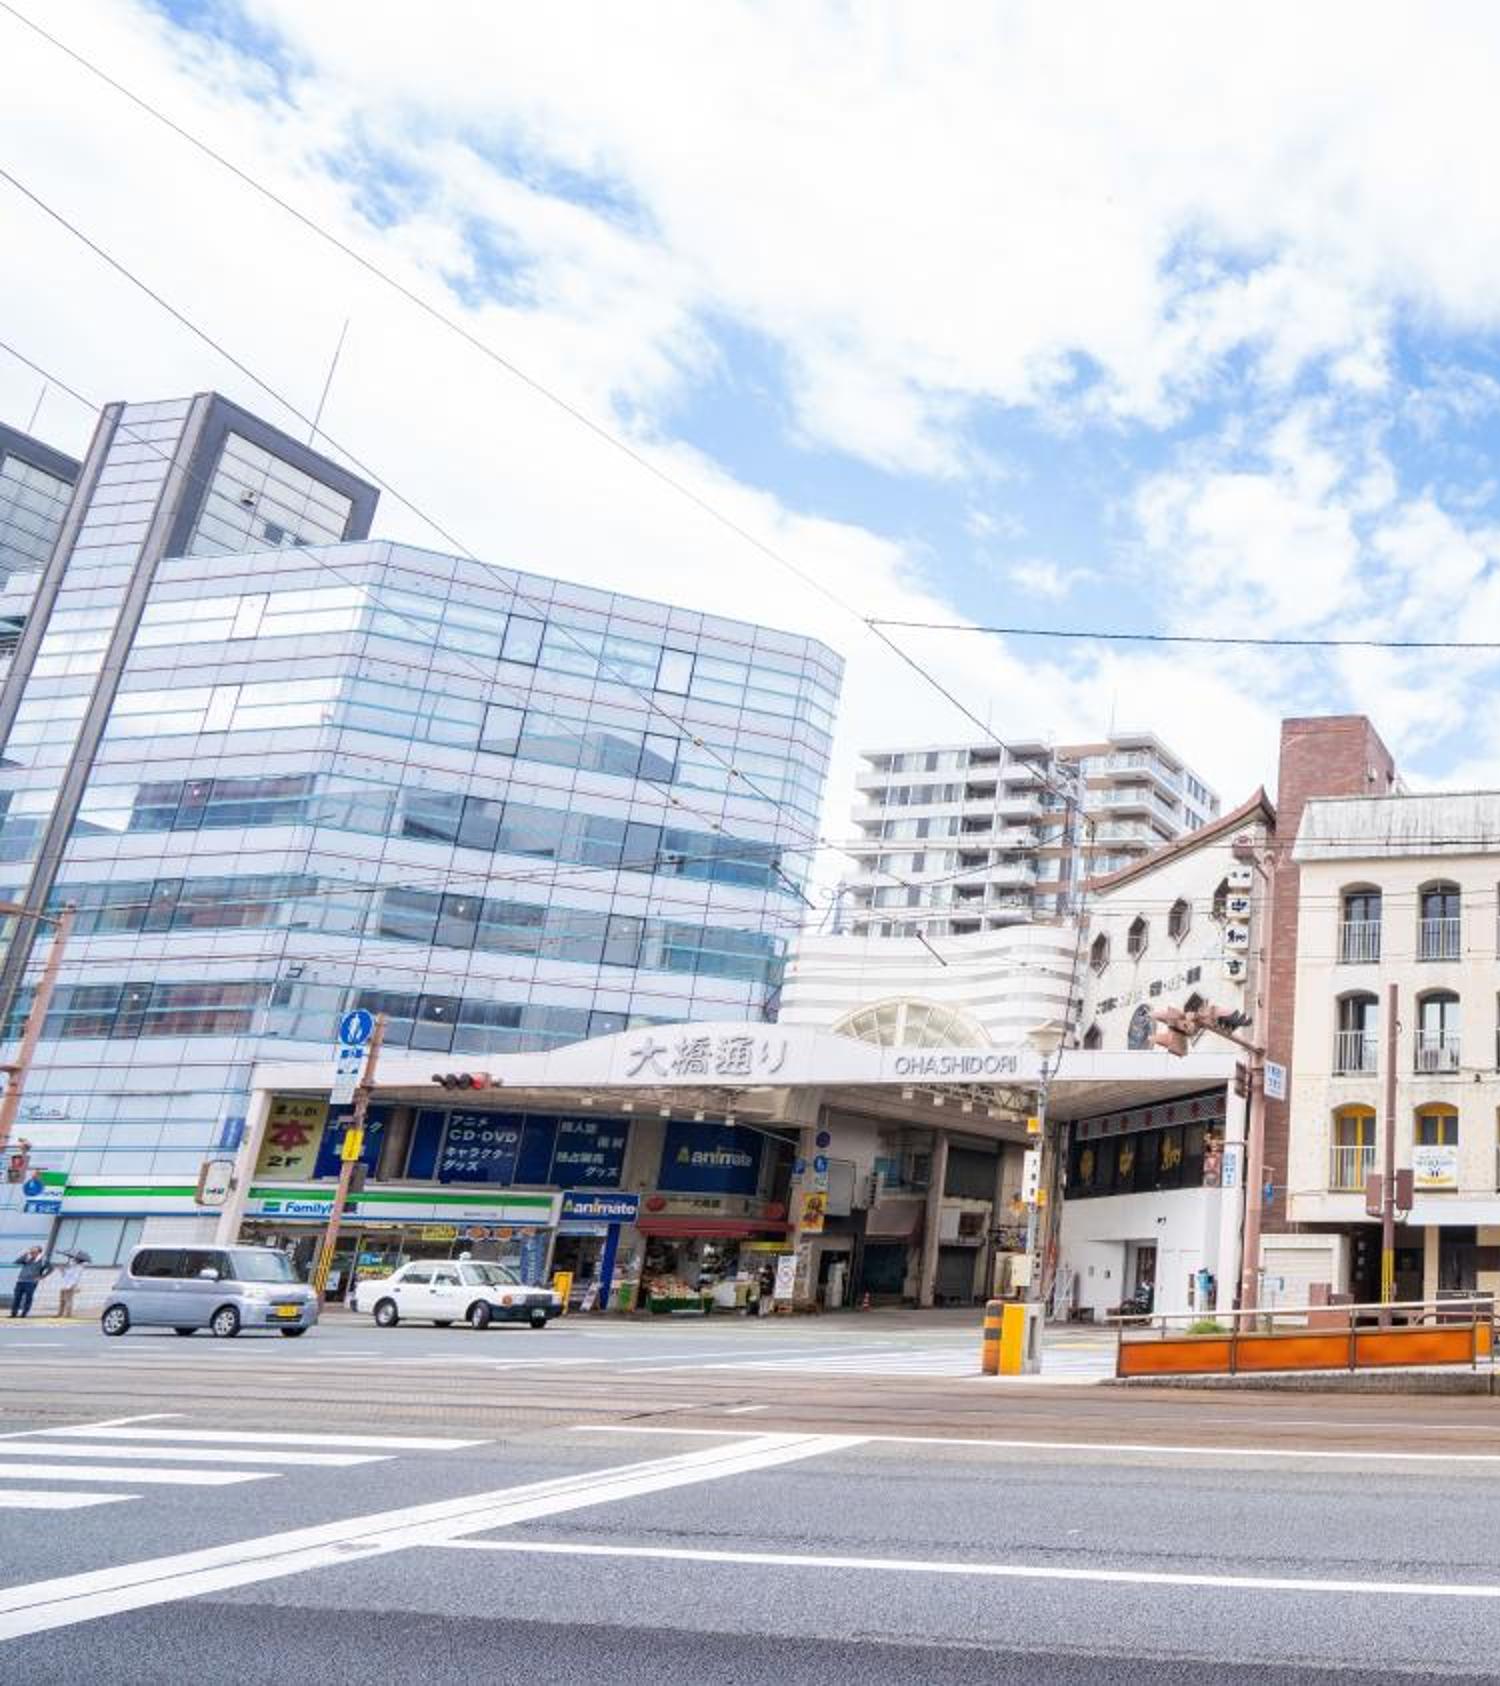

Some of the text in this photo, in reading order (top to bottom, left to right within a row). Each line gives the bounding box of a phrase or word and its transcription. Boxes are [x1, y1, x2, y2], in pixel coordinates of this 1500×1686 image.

[625, 1036, 789, 1079] 大橋通り
[894, 1054, 1018, 1077] OHASHIDORI
[451, 1115, 488, 1127] アニメ
[268, 1119, 315, 1151] 本
[446, 1147, 514, 1159] キャラクター
[690, 1145, 753, 1167] animate
[266, 1155, 303, 1168] 2F
[442, 1159, 480, 1172] グッズ
[584, 1166, 618, 1178] グッズ
[573, 1197, 636, 1216] animate
